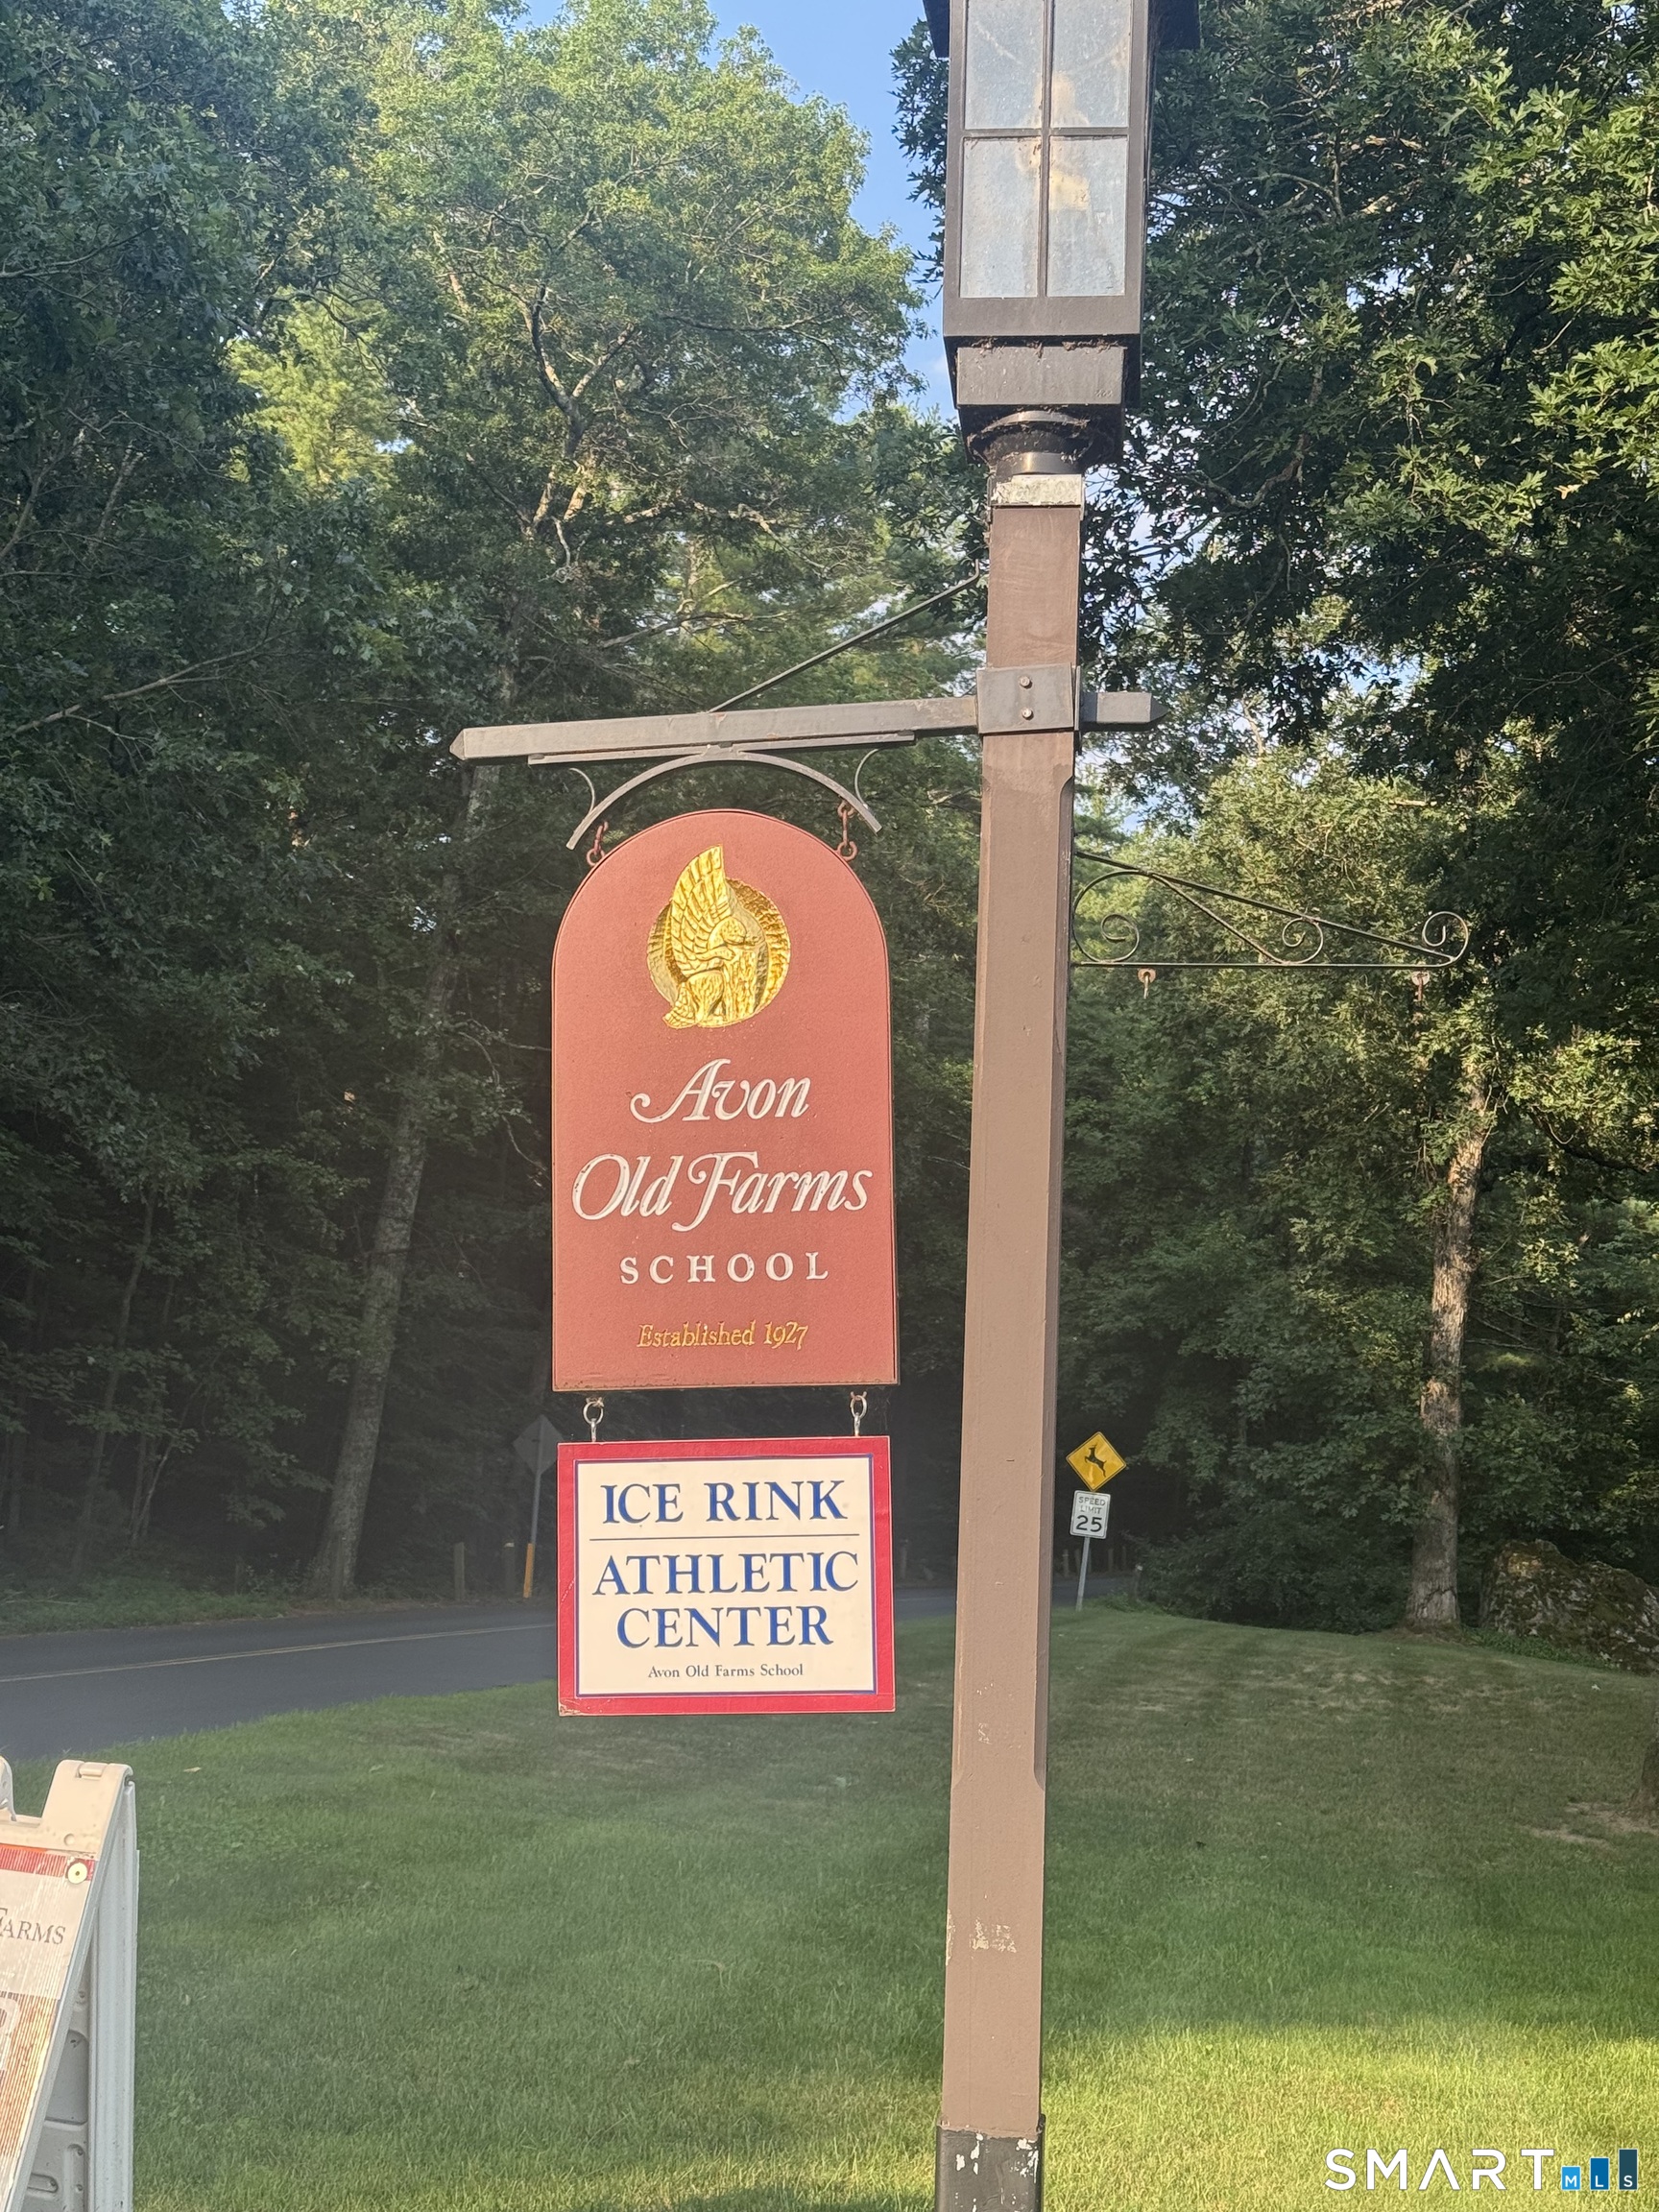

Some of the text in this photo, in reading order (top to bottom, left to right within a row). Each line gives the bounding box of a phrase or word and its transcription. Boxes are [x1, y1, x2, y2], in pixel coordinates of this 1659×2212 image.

[629, 1057, 811, 1123] Avon
[571, 1150, 873, 1232] Old Farms
[619, 1251, 829, 1285] SCHOOL
[636, 1319, 809, 1350] Established 1927
[600, 1479, 849, 1525] ICE RINK
[1078, 1496, 1106, 1505] SPEED
[1080, 1505, 1102, 1514] LIMIT
[1076, 1515, 1102, 1532] 25
[591, 1551, 859, 1596] ATHLETIC
[616, 1605, 834, 1649] CENTER
[648, 1663, 804, 1678] Avon Old Farms School
